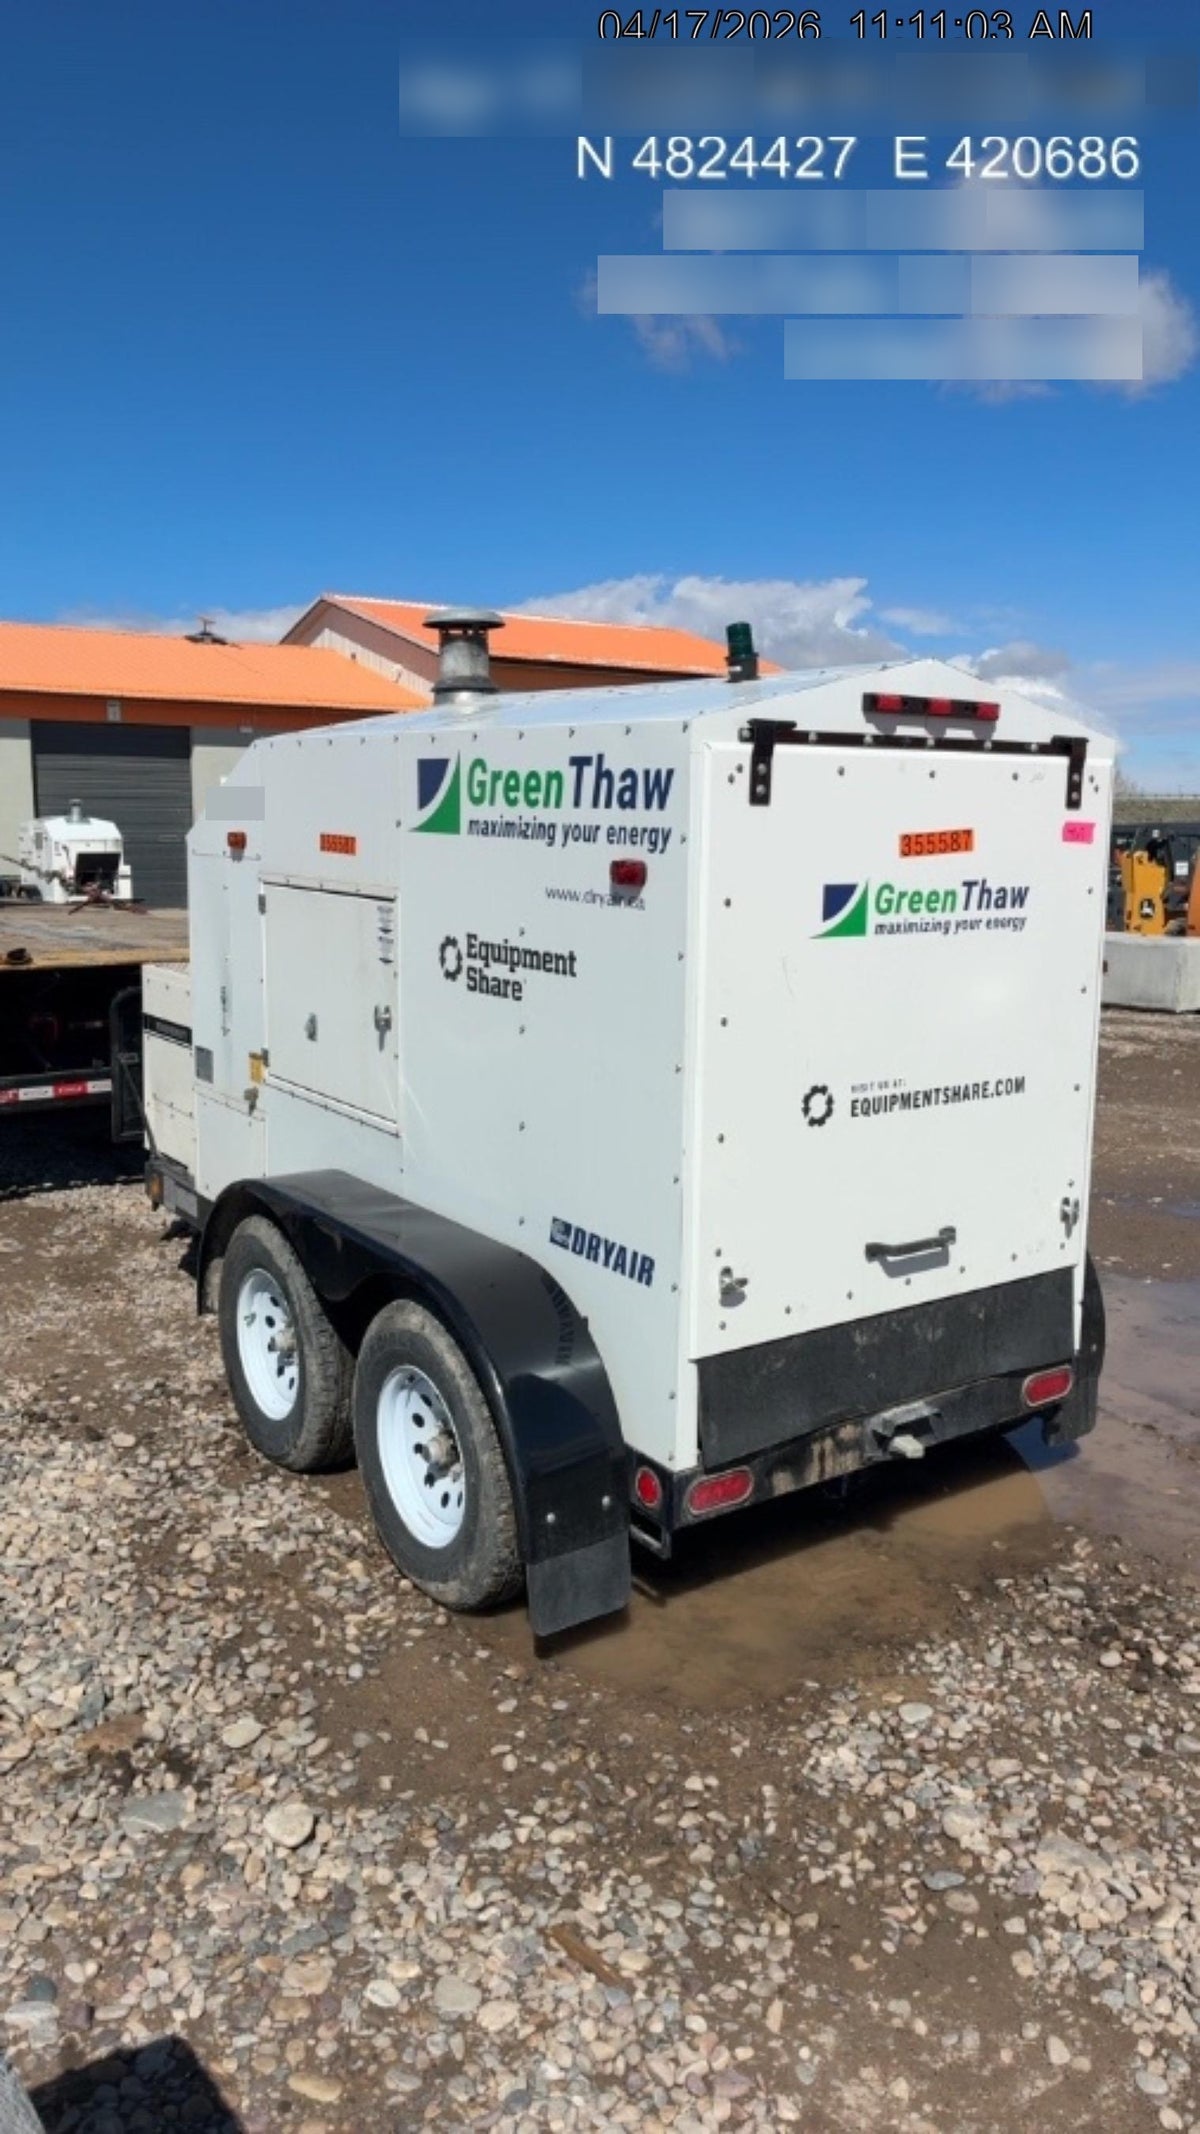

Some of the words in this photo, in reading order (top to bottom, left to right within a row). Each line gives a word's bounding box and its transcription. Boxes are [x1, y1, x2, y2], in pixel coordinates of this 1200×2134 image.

[467, 814, 557, 847] maximizing
[561, 822, 601, 848] your
[606, 824, 672, 854] energy
[901, 829, 972, 856] 355587
[874, 918, 951, 936] maximizing
[953, 917, 983, 935] your
[986, 916, 1027, 932] energy
[466, 932, 577, 978] Equipment
[466, 966, 523, 1001] Share
[850, 1076, 1026, 1118] EQUIPMENTSHARE.COM
[571, 1226, 656, 1288] DRYAIR
